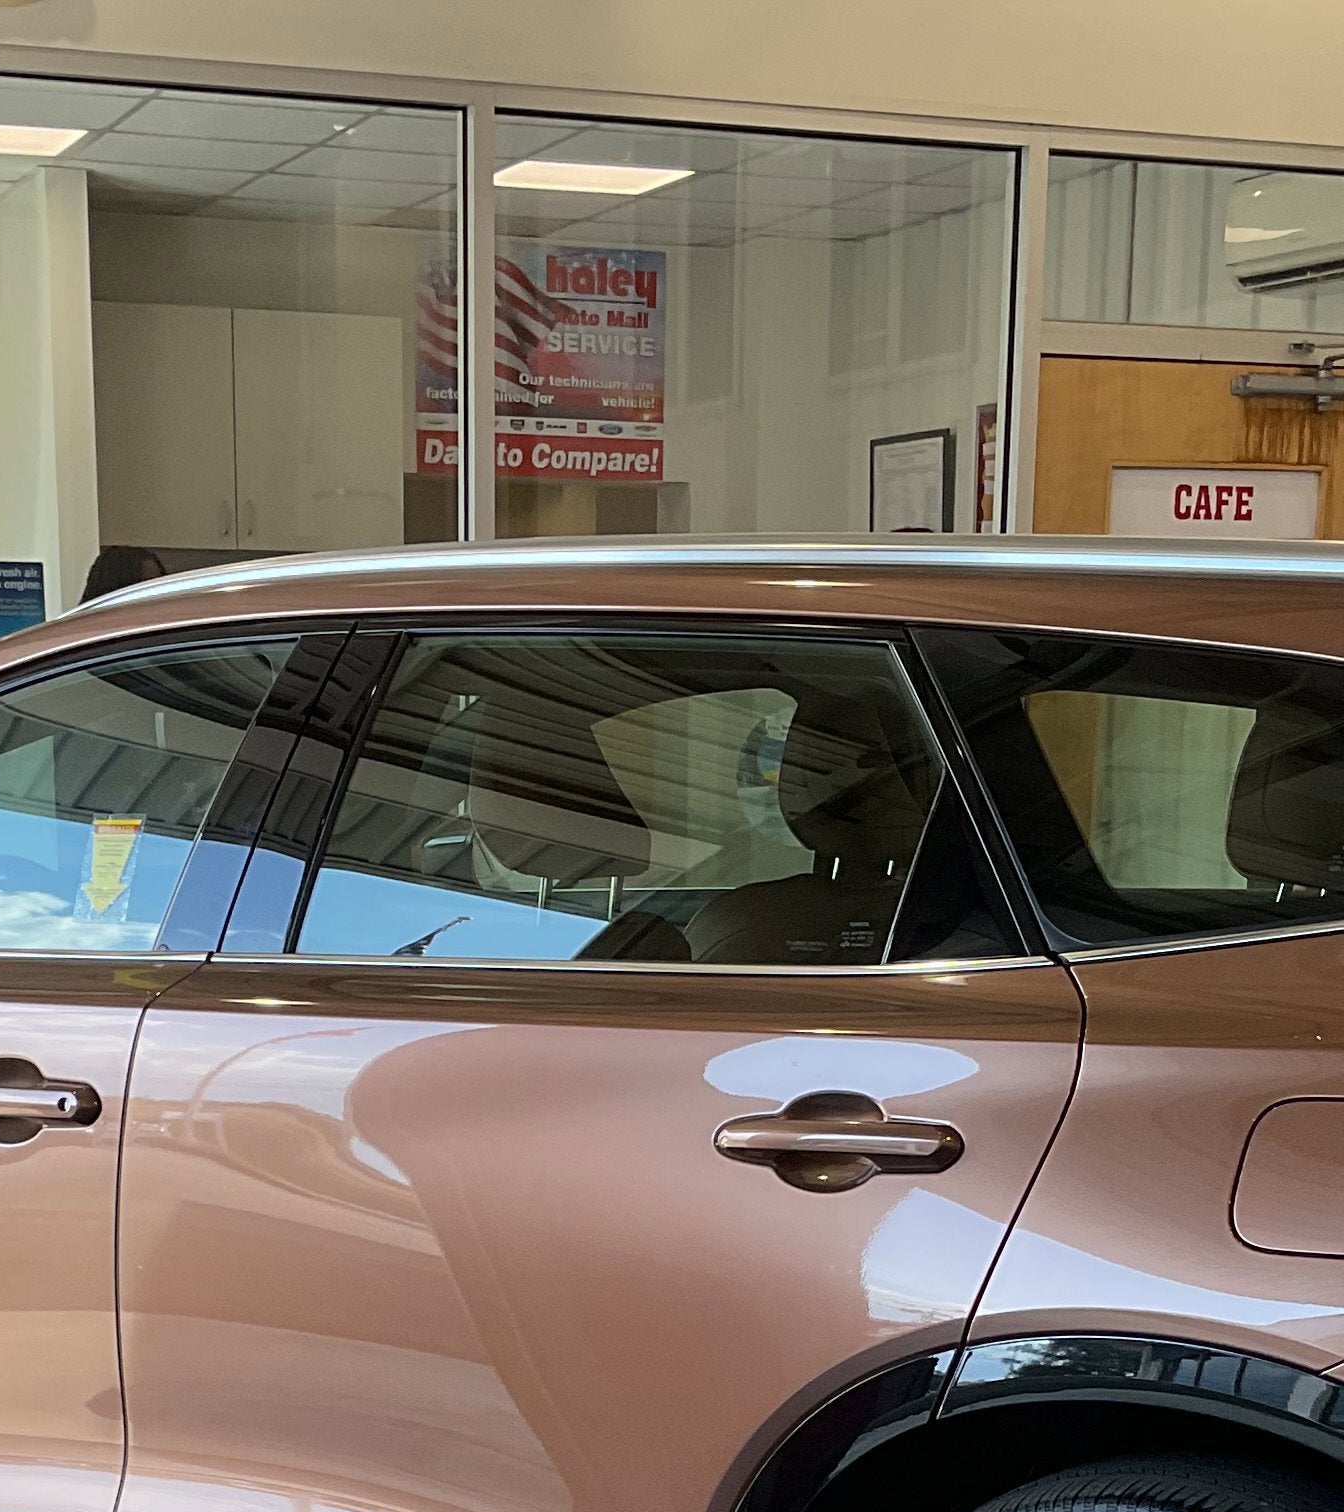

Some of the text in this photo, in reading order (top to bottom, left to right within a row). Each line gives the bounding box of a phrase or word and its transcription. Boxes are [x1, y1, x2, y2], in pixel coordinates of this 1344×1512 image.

[546, 255, 657, 309] haley
[607, 311, 649, 328] Mall
[547, 331, 656, 357] SERVICE
[518, 373, 545, 387] Our
[496, 442, 523, 467] to
[531, 443, 659, 476] Compare!
[1173, 484, 1254, 521] CAFE
